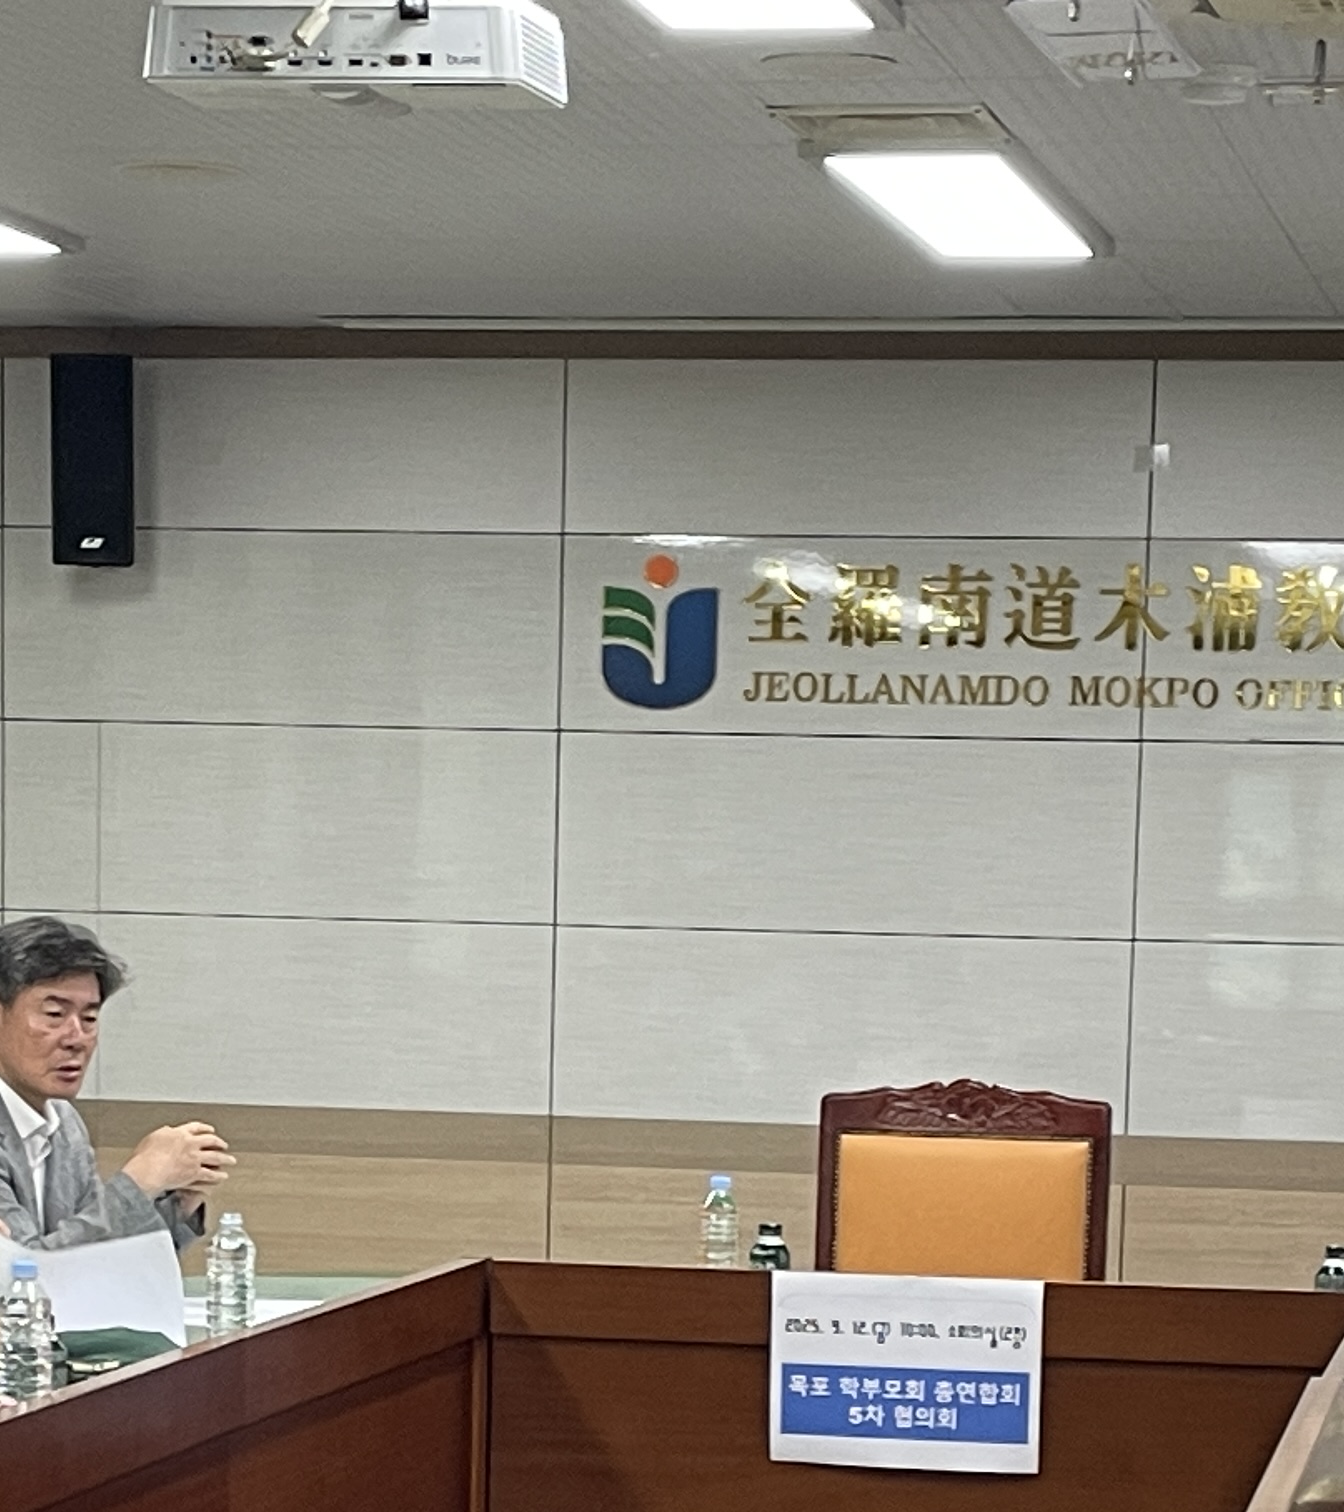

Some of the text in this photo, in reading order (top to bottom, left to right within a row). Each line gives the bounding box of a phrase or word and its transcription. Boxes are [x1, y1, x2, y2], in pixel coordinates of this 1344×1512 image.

[743, 670, 1050, 707] JEOLLANAMDO
[1068, 674, 1220, 710] MOKPO
[788, 1374, 1021, 1406] 목포 학부모회 총연합회
[848, 1404, 958, 1430] 5차 협의회
